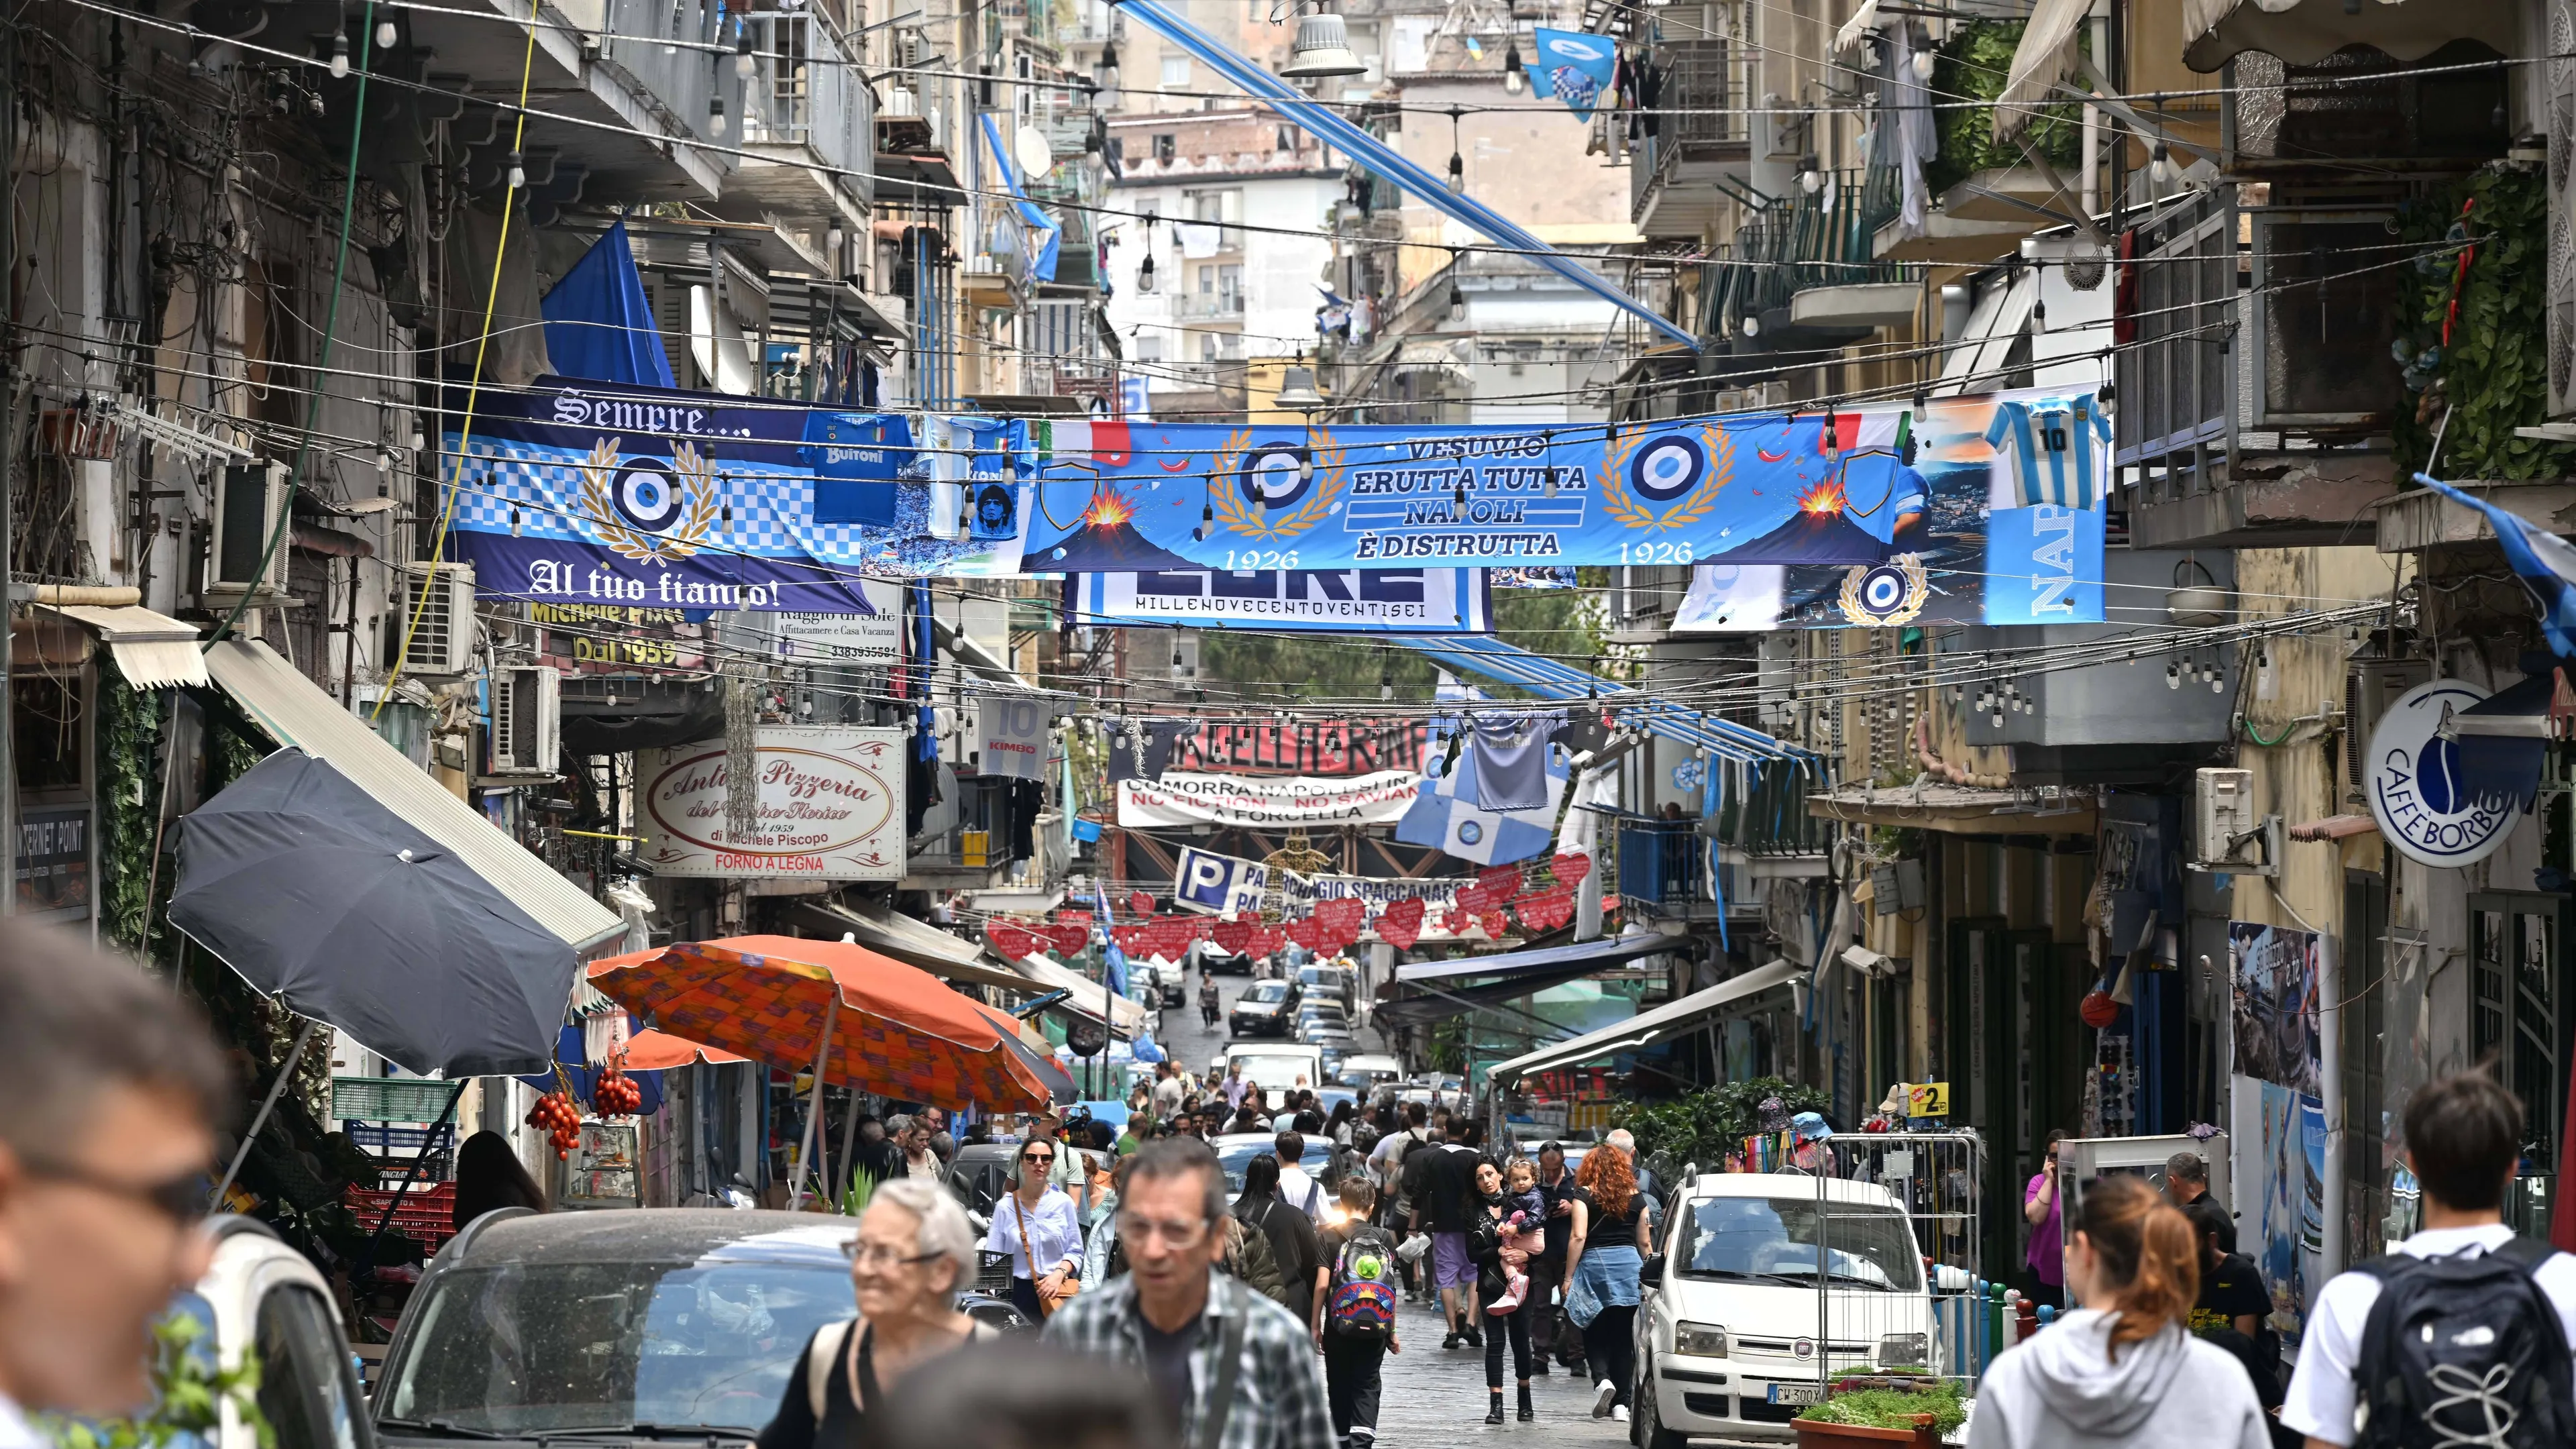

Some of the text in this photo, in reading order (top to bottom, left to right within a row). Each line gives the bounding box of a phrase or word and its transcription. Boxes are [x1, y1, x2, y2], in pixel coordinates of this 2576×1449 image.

[1407, 437, 1546, 460] VESUVIO
[2038, 428, 2067, 451] 10
[1351, 466, 1589, 495] ERUTTA TUTTA
[1403, 499, 1527, 527] NAPOLI
[1354, 532, 1561, 560] È DISTRUTTA
[1620, 542, 1693, 565] 1926
[1226, 549, 1299, 570] 1926
[529, 559, 575, 596] Al
[588, 568, 645, 600] tuo
[1136, 597, 1426, 618] MILLENOVECENTOVENTISEI
[780, 624, 832, 634] Affittacamere
[841, 625, 859, 635] Casa
[862, 625, 895, 636] Vacanza
[622, 639, 677, 664] 1959
[996, 699, 1038, 738] 10
[989, 741, 1036, 754] KIMBO
[762, 759, 877, 802] Pizzeria
[1295, 797, 1329, 808] NO
[1337, 786, 1421, 805] SAVIAN
[784, 801, 853, 820] Storico
[58, 820, 83, 853] POINT
[710, 829, 722, 841] di
[778, 833, 828, 847] Piscopo
[768, 824, 794, 833] 1959
[715, 854, 824, 871] FORNO A LEGNA
[1925, 1087, 1939, 1112] 2
[1799, 1345, 1809, 1353] FIAT
